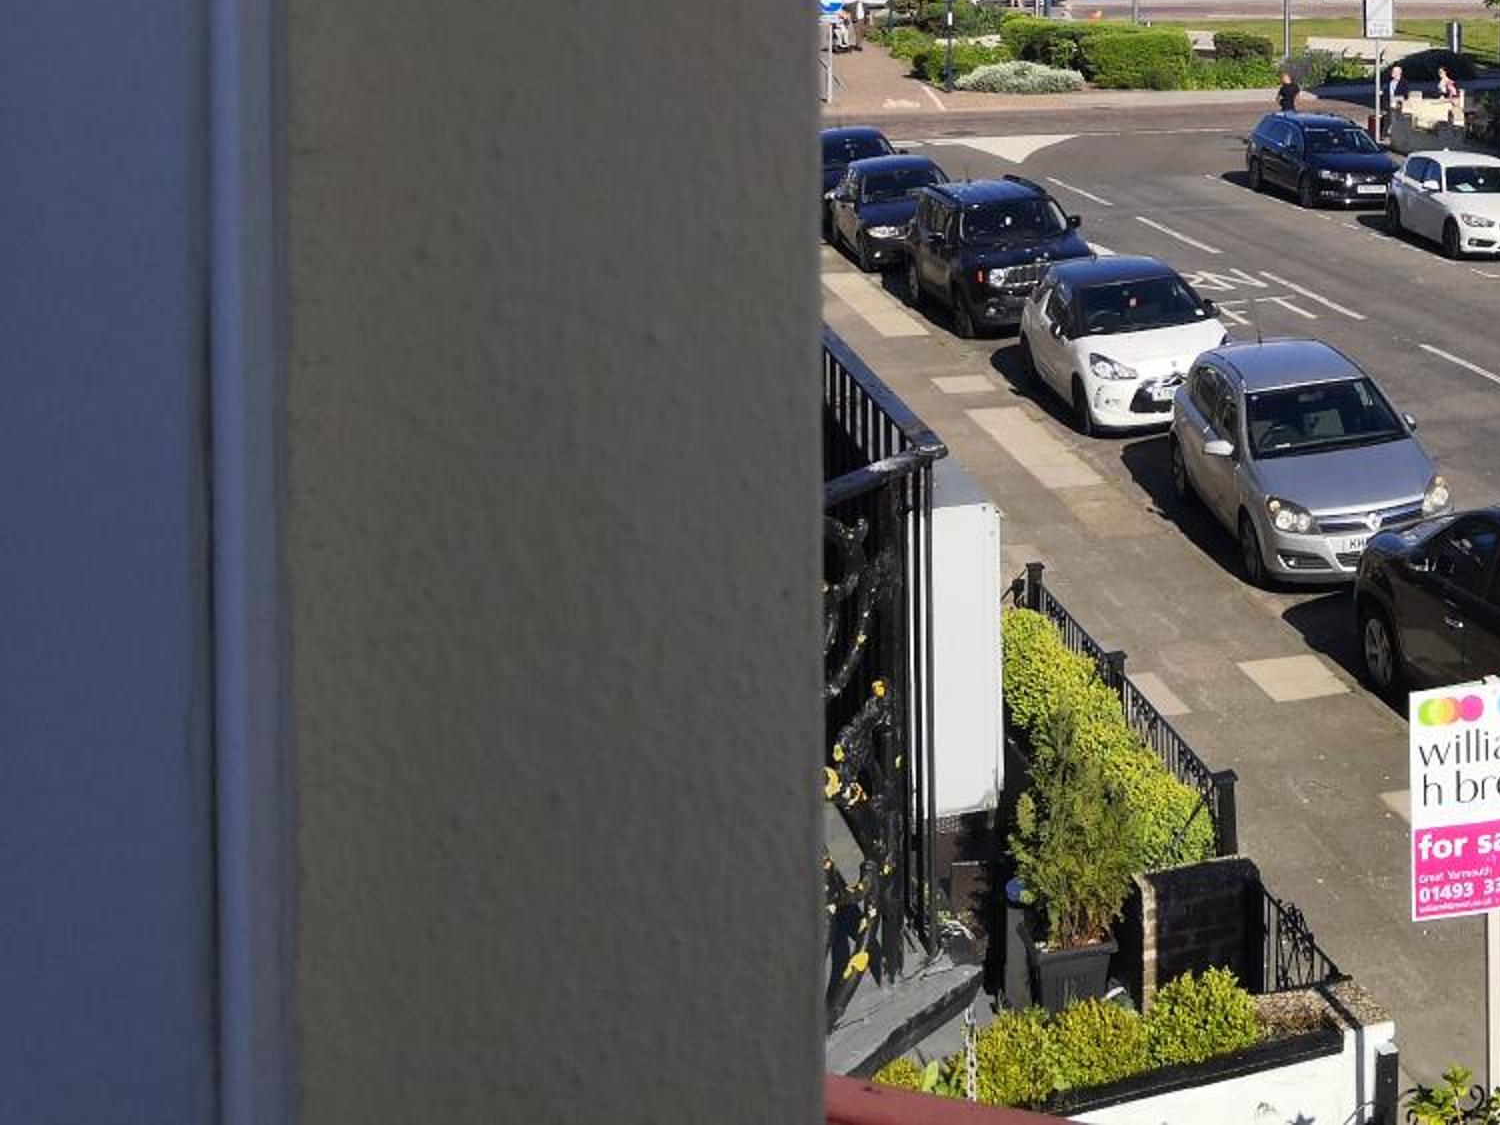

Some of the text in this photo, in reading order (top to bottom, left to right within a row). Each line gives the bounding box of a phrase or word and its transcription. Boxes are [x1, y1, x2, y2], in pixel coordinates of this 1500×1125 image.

[1423, 773, 1443, 807] h
[1418, 834, 1468, 862] for
[1419, 881, 1475, 903] 01493
